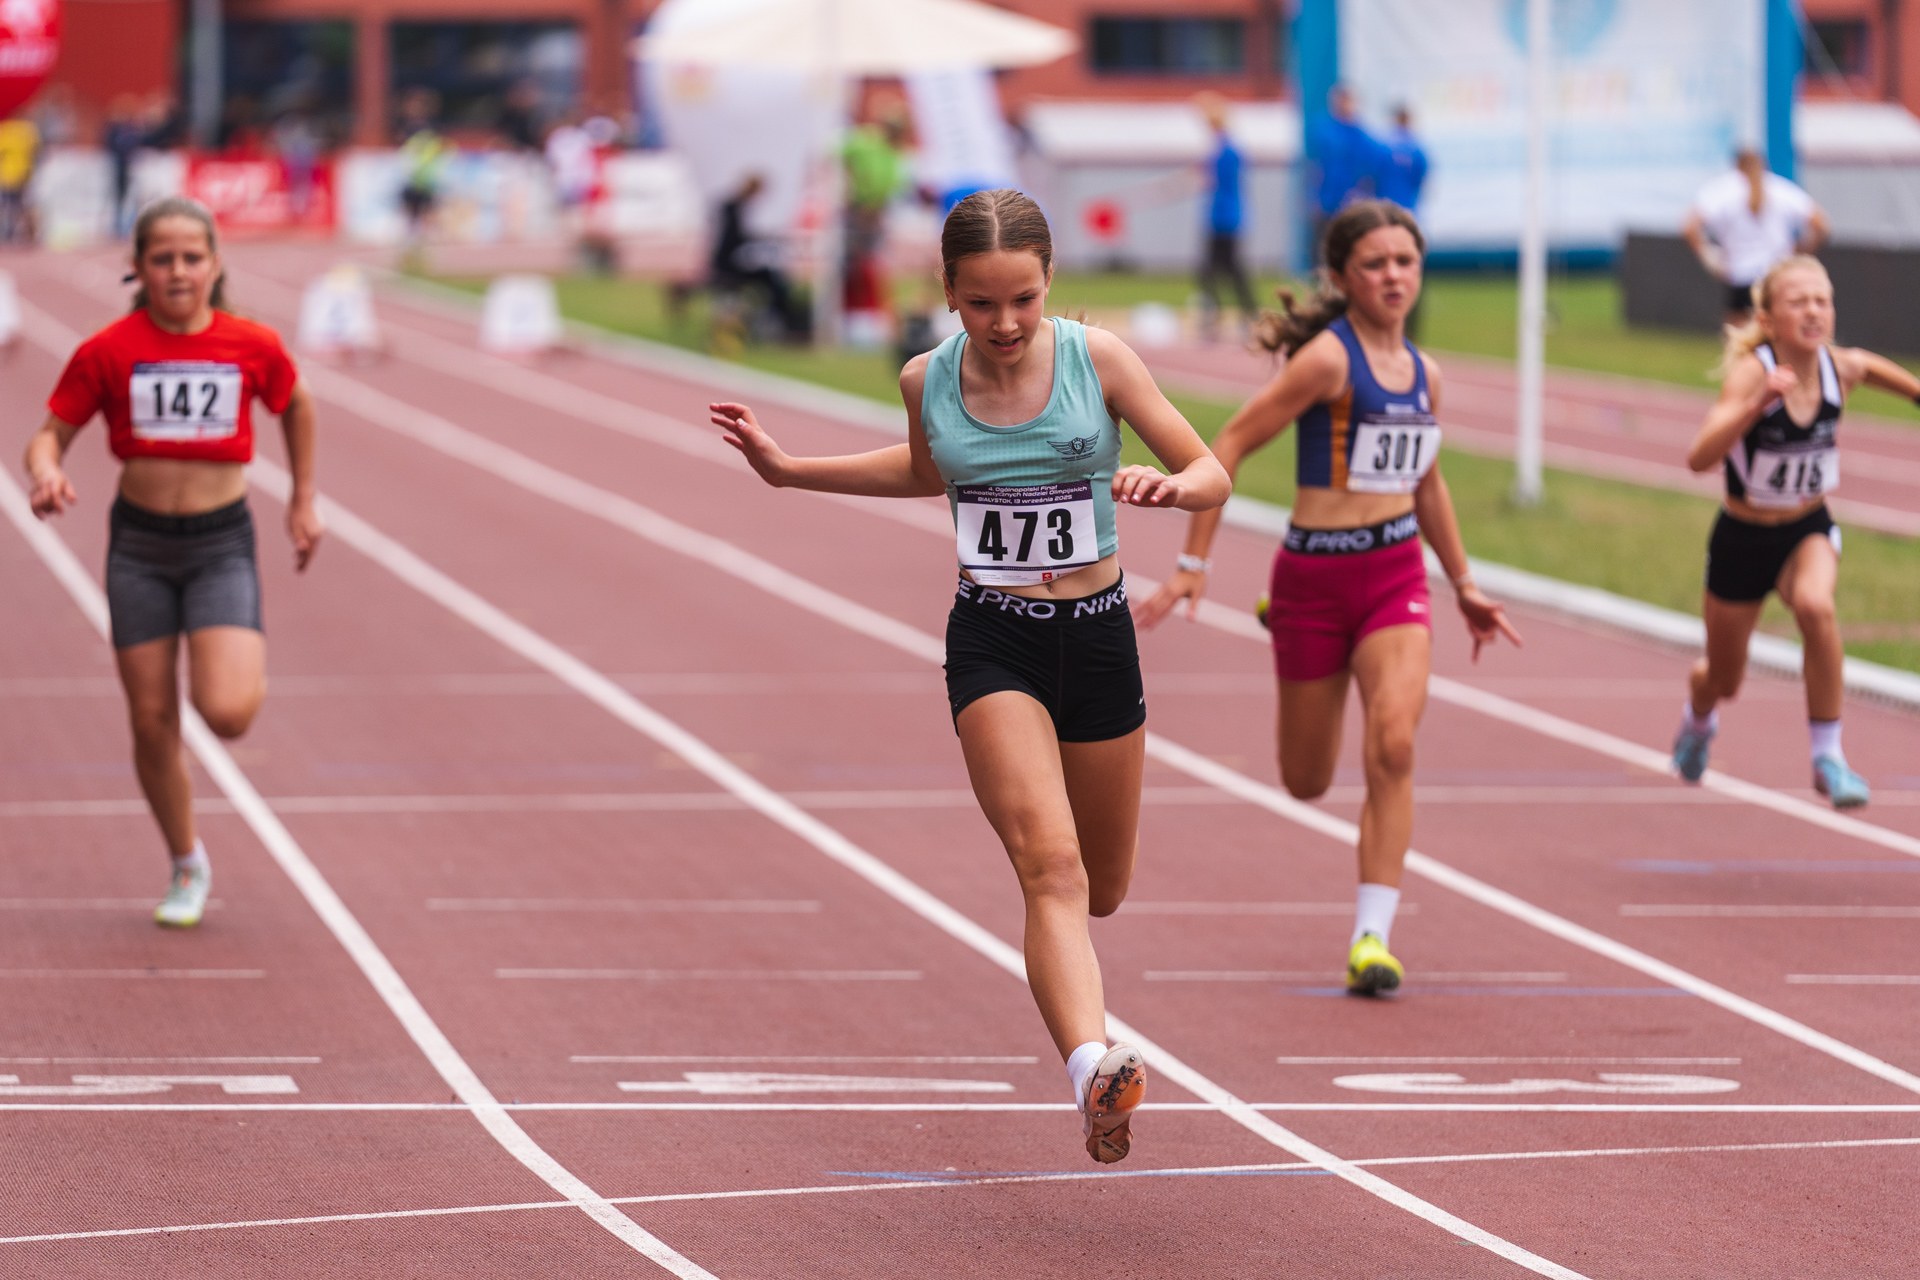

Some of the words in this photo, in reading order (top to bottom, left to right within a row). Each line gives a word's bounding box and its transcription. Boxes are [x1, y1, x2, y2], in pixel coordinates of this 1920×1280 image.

[154, 382, 218, 418] 142
[1374, 432, 1422, 471] 301
[978, 508, 1074, 562] 473
[1306, 528, 1374, 552] PRO
[977, 587, 1056, 619] PRO
[1332, 1073, 1741, 1094] 3
